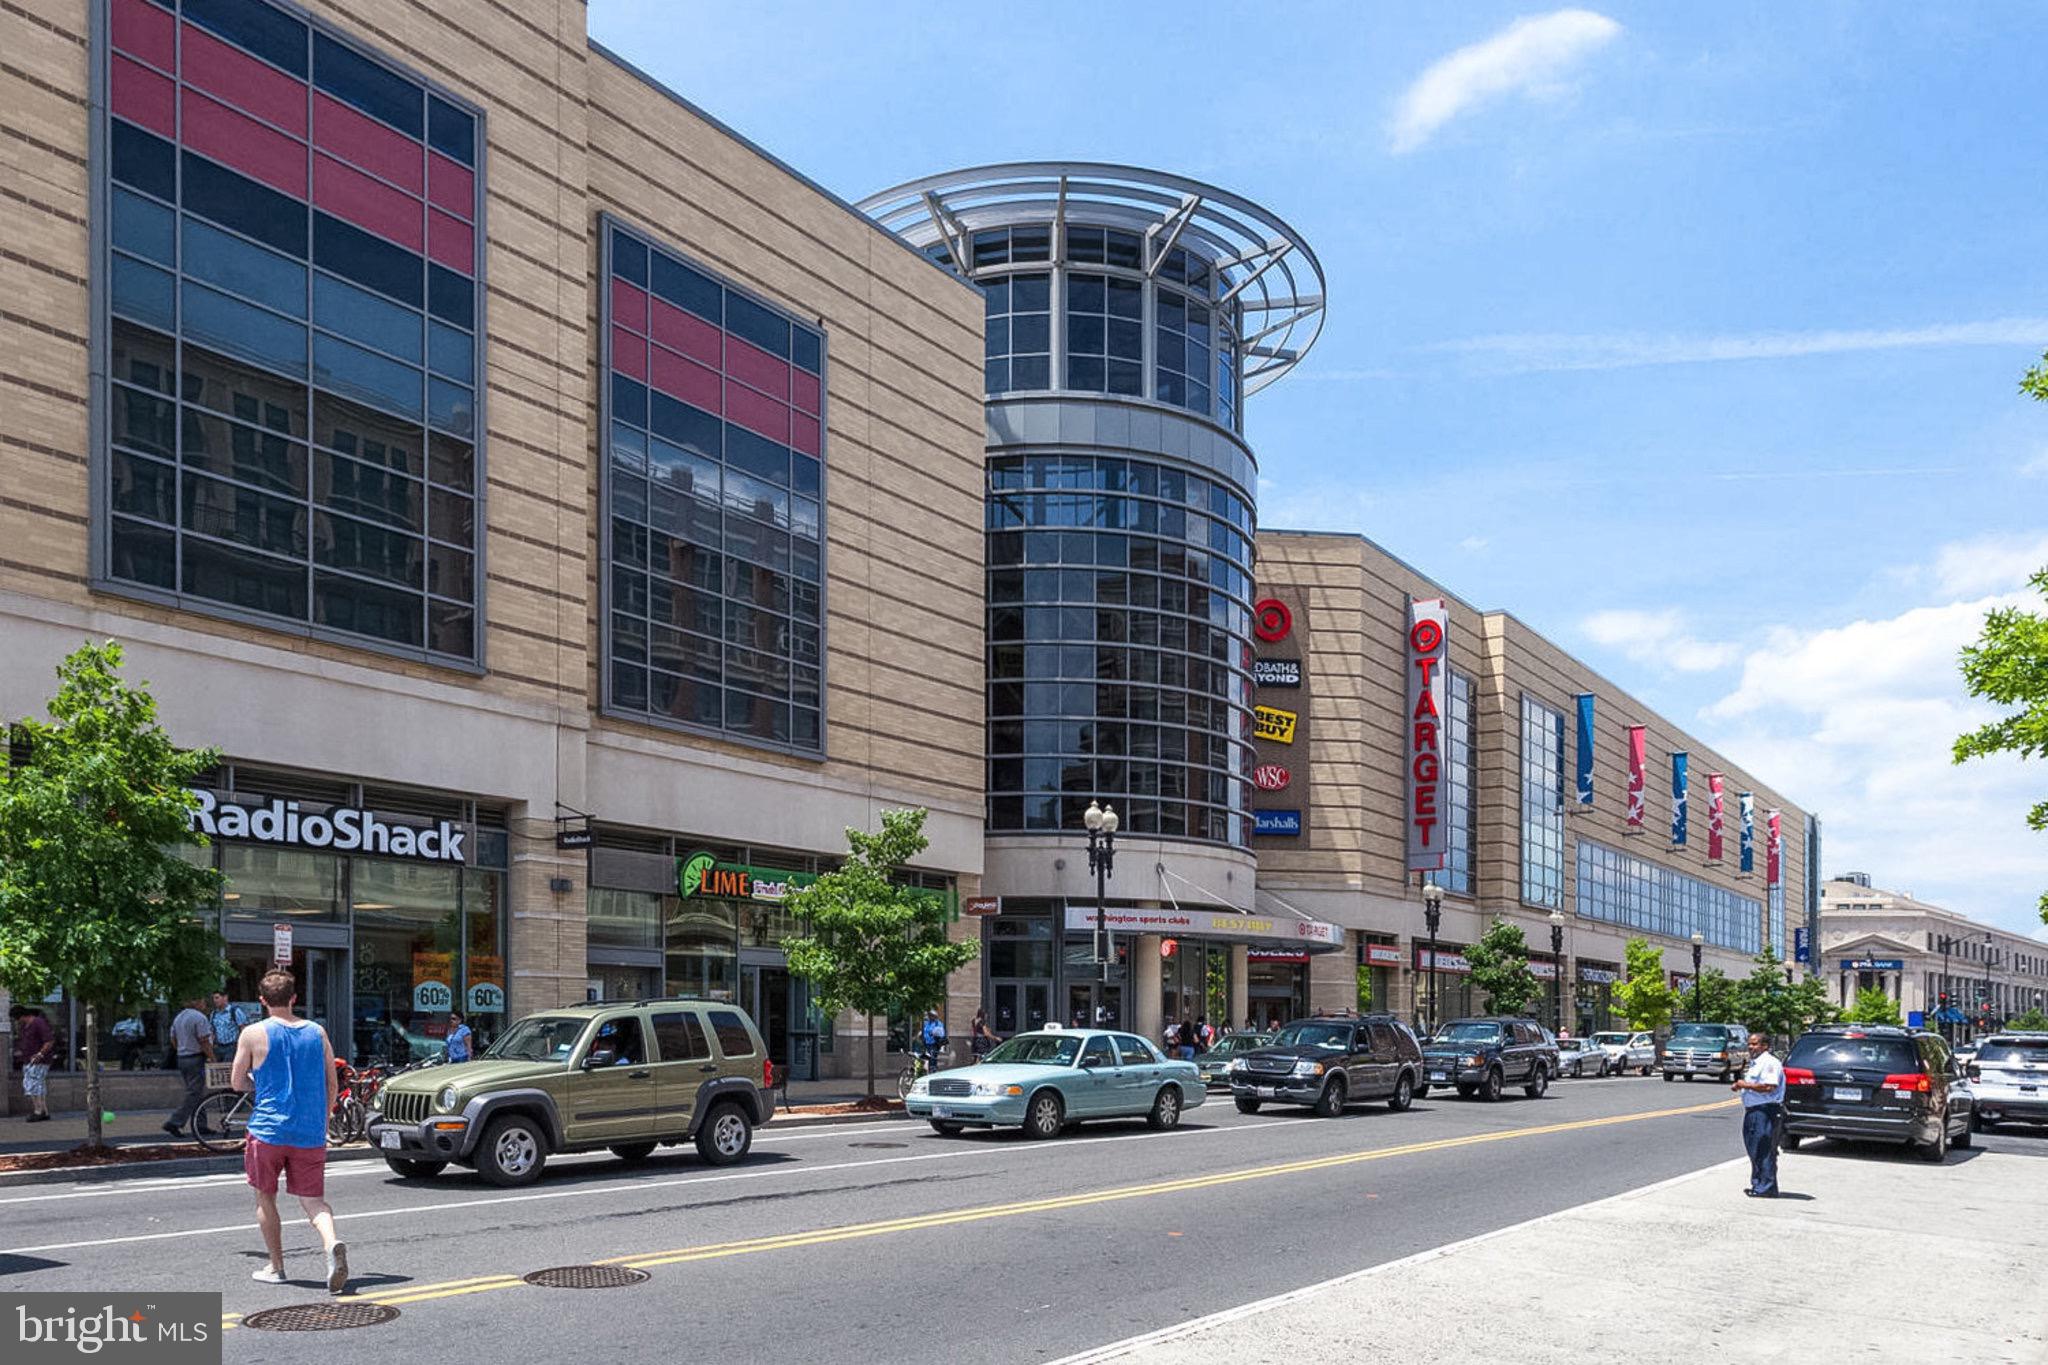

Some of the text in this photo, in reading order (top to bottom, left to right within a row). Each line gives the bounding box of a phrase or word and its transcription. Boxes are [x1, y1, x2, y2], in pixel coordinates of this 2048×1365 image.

[1255, 710, 1294, 726] BEST
[1255, 722, 1289, 737] BUY
[1413, 658, 1438, 847] TARGET
[1256, 766, 1285, 787] WSC
[184, 788, 466, 861] RadioShack
[701, 868, 750, 897] LIME
